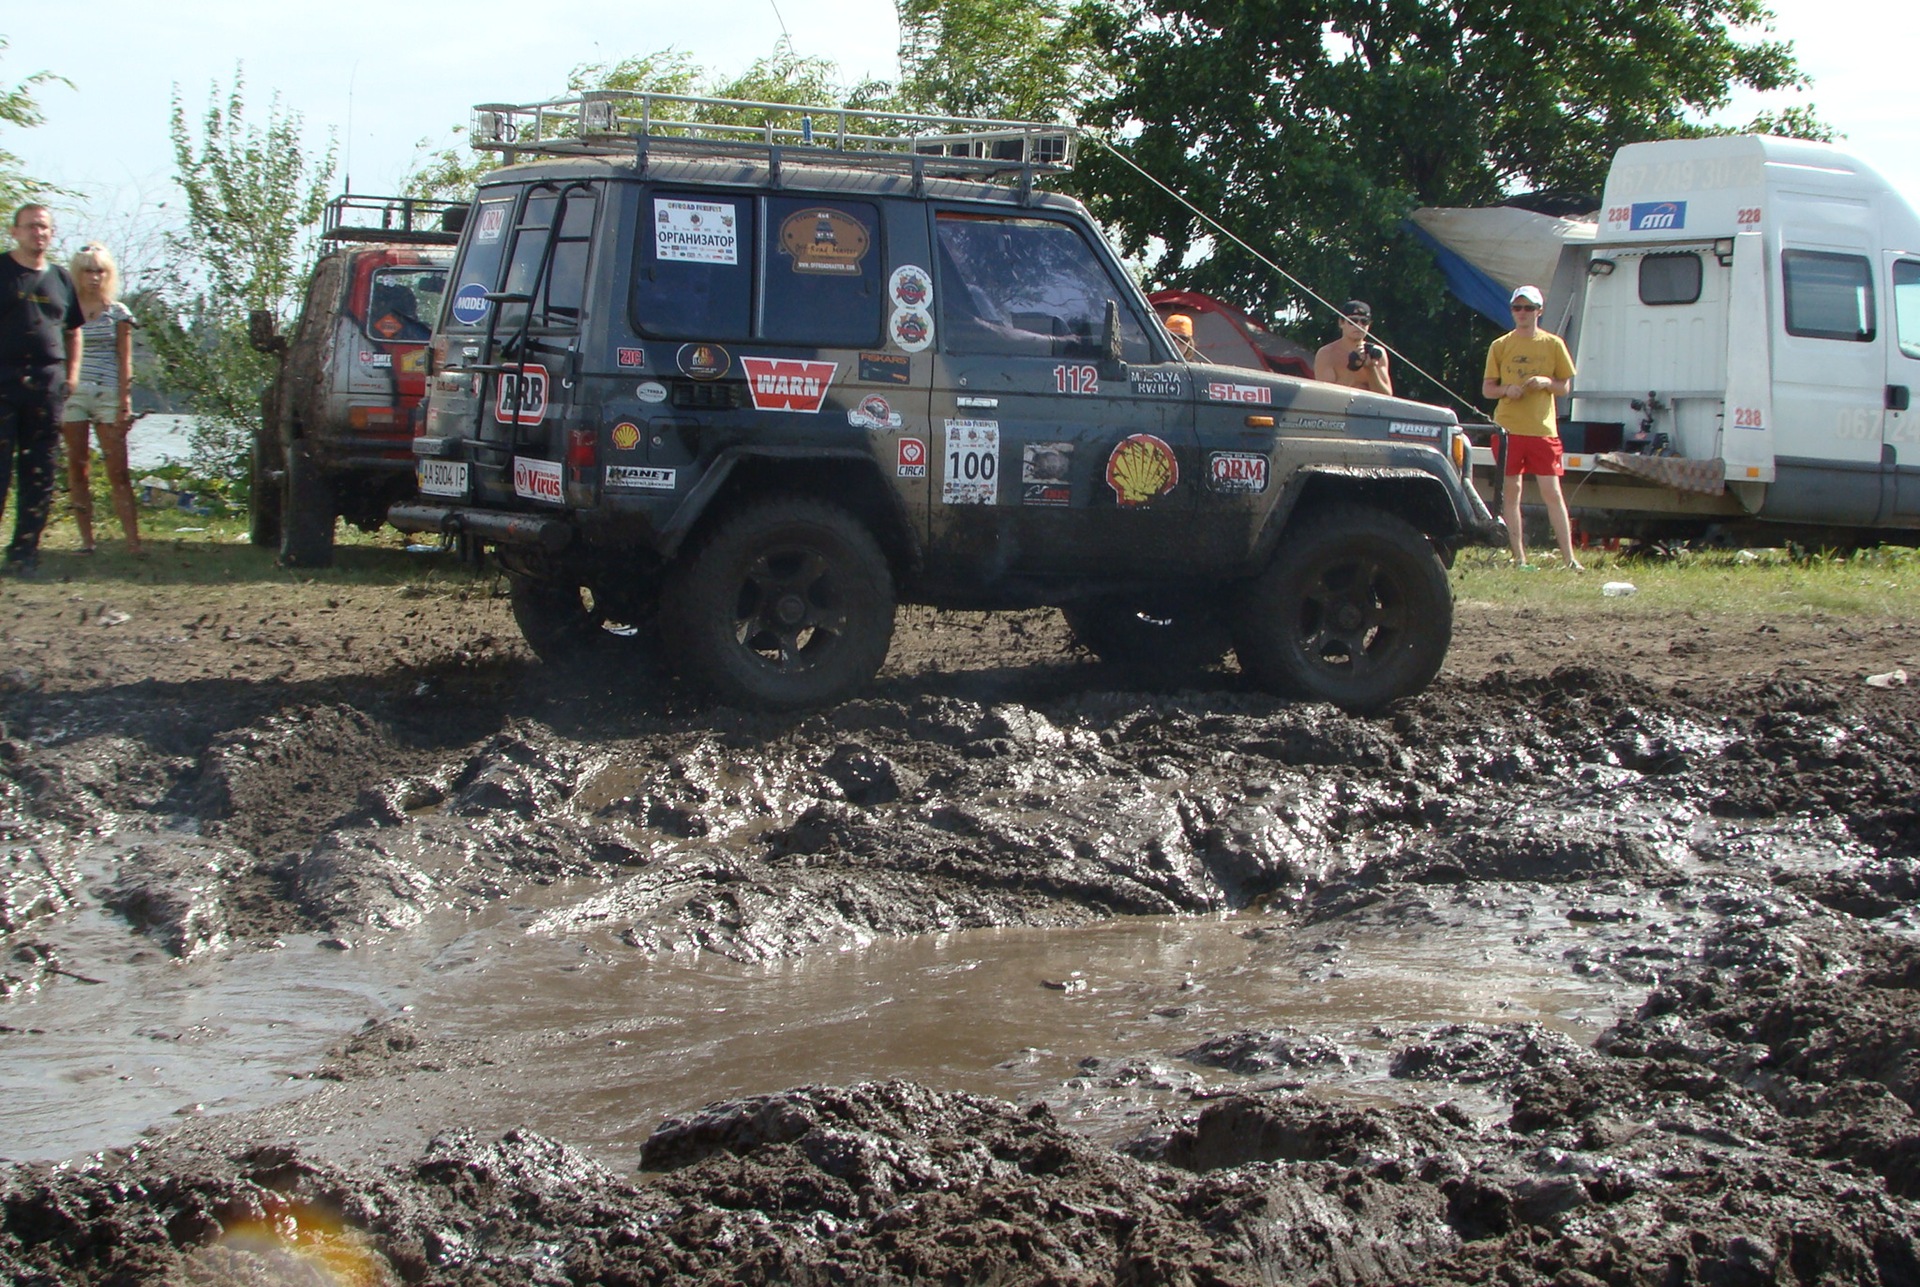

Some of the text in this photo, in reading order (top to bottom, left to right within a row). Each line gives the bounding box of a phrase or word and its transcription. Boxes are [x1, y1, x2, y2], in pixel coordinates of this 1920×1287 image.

[1608, 207, 1629, 222] 238
[1737, 208, 1761, 224] 228
[658, 231, 735, 247] ОРГАНИЗАТОР
[620, 349, 642, 365] ZIC
[861, 353, 908, 364] FISKARS
[757, 374, 820, 397] WARN
[1053, 365, 1098, 394] 112
[502, 375, 543, 411] ARB
[1210, 383, 1270, 403] Shell
[1735, 408, 1762, 427] 238
[1836, 408, 1883, 440] 067
[1388, 421, 1442, 437] PLANET
[898, 465, 924, 476] CIRCA
[950, 451, 996, 480] 100
[528, 469, 560, 497] Virus
